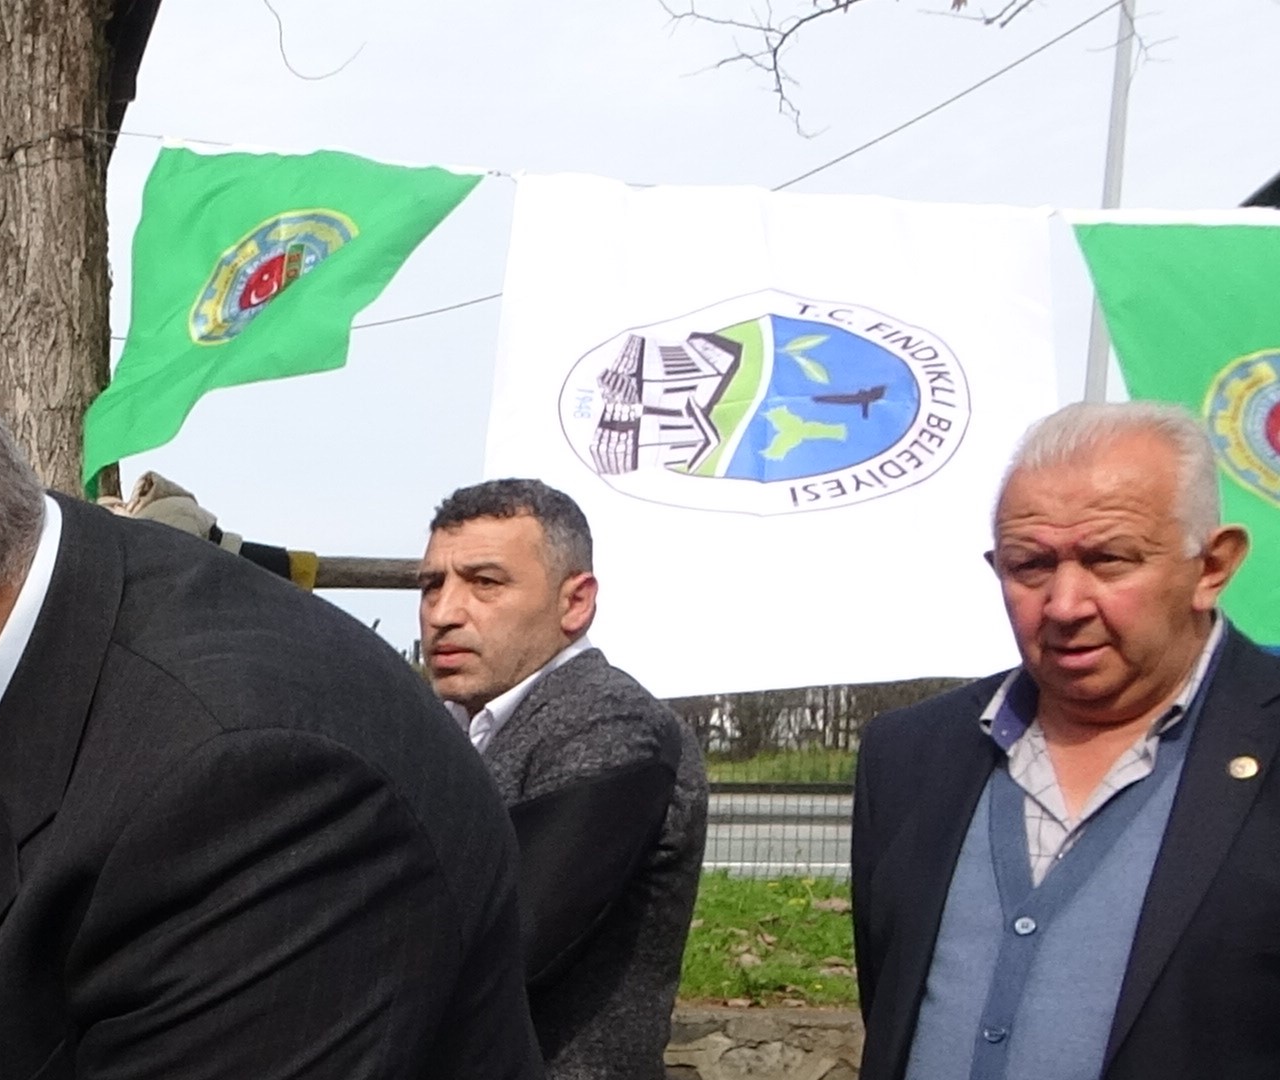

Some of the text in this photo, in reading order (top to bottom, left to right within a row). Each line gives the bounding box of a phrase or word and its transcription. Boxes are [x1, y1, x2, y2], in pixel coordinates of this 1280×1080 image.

[788, 302, 958, 507] T.C. FINDIKLI BELEDİYESİ
